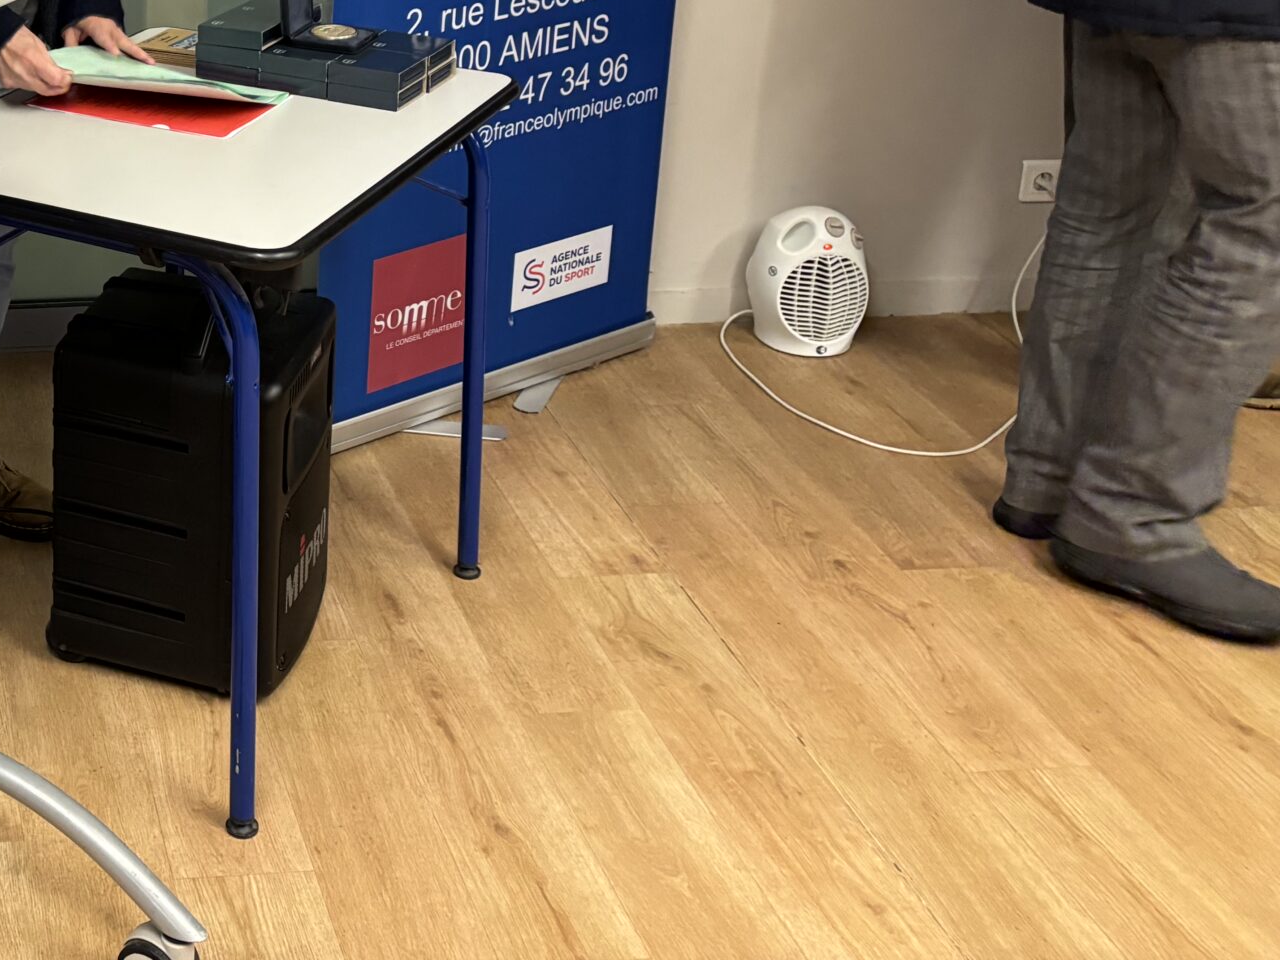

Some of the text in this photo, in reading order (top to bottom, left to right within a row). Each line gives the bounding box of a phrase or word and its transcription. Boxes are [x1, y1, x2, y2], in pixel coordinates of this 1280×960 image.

[440, 2, 484, 33] rue
[455, 14, 610, 71] 00 AMIENS
[519, 53, 629, 105] 47 34 96
[448, 86, 659, 152] @franceolympique.com
[549, 252, 602, 276] NATIONALE
[550, 244, 590, 265] AGENCE
[548, 265, 596, 288] DU SPORT
[373, 290, 462, 336] somme
[395, 333, 422, 347] CONSEIL
